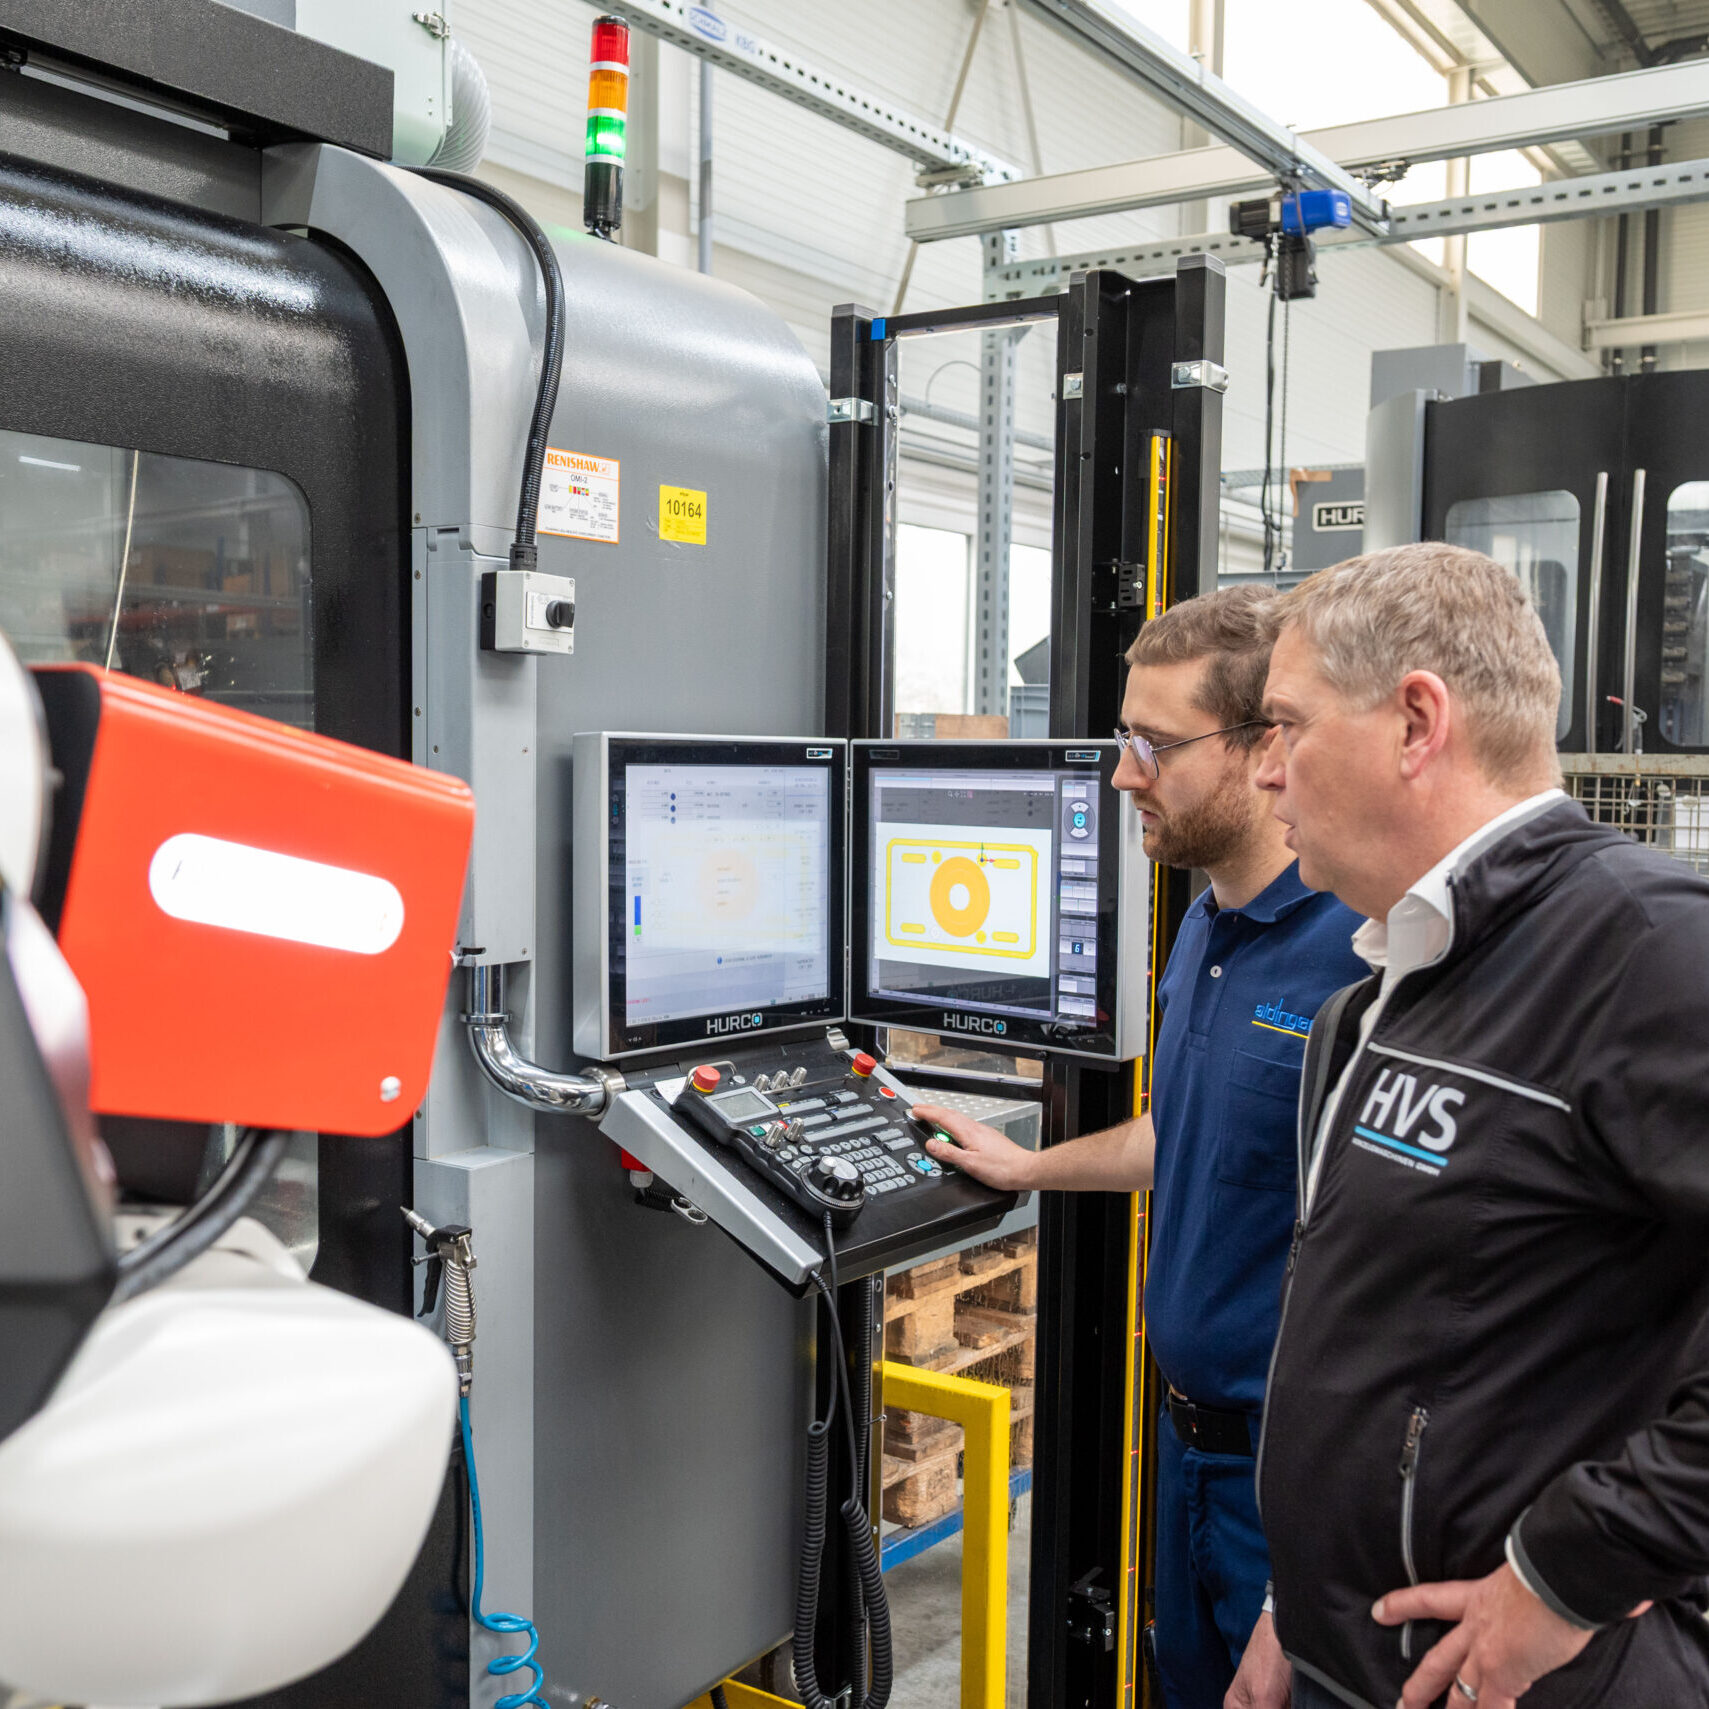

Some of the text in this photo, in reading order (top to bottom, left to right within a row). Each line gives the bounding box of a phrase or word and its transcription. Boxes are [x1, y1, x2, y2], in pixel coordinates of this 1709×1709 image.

[547, 453, 600, 473] RENISHAW
[666, 498, 702, 519] 10164
[1321, 507, 1365, 525] HUR
[707, 1013, 763, 1035] HURCO
[943, 1012, 1007, 1035] HURCO
[1360, 1068, 1465, 1151] HVS
